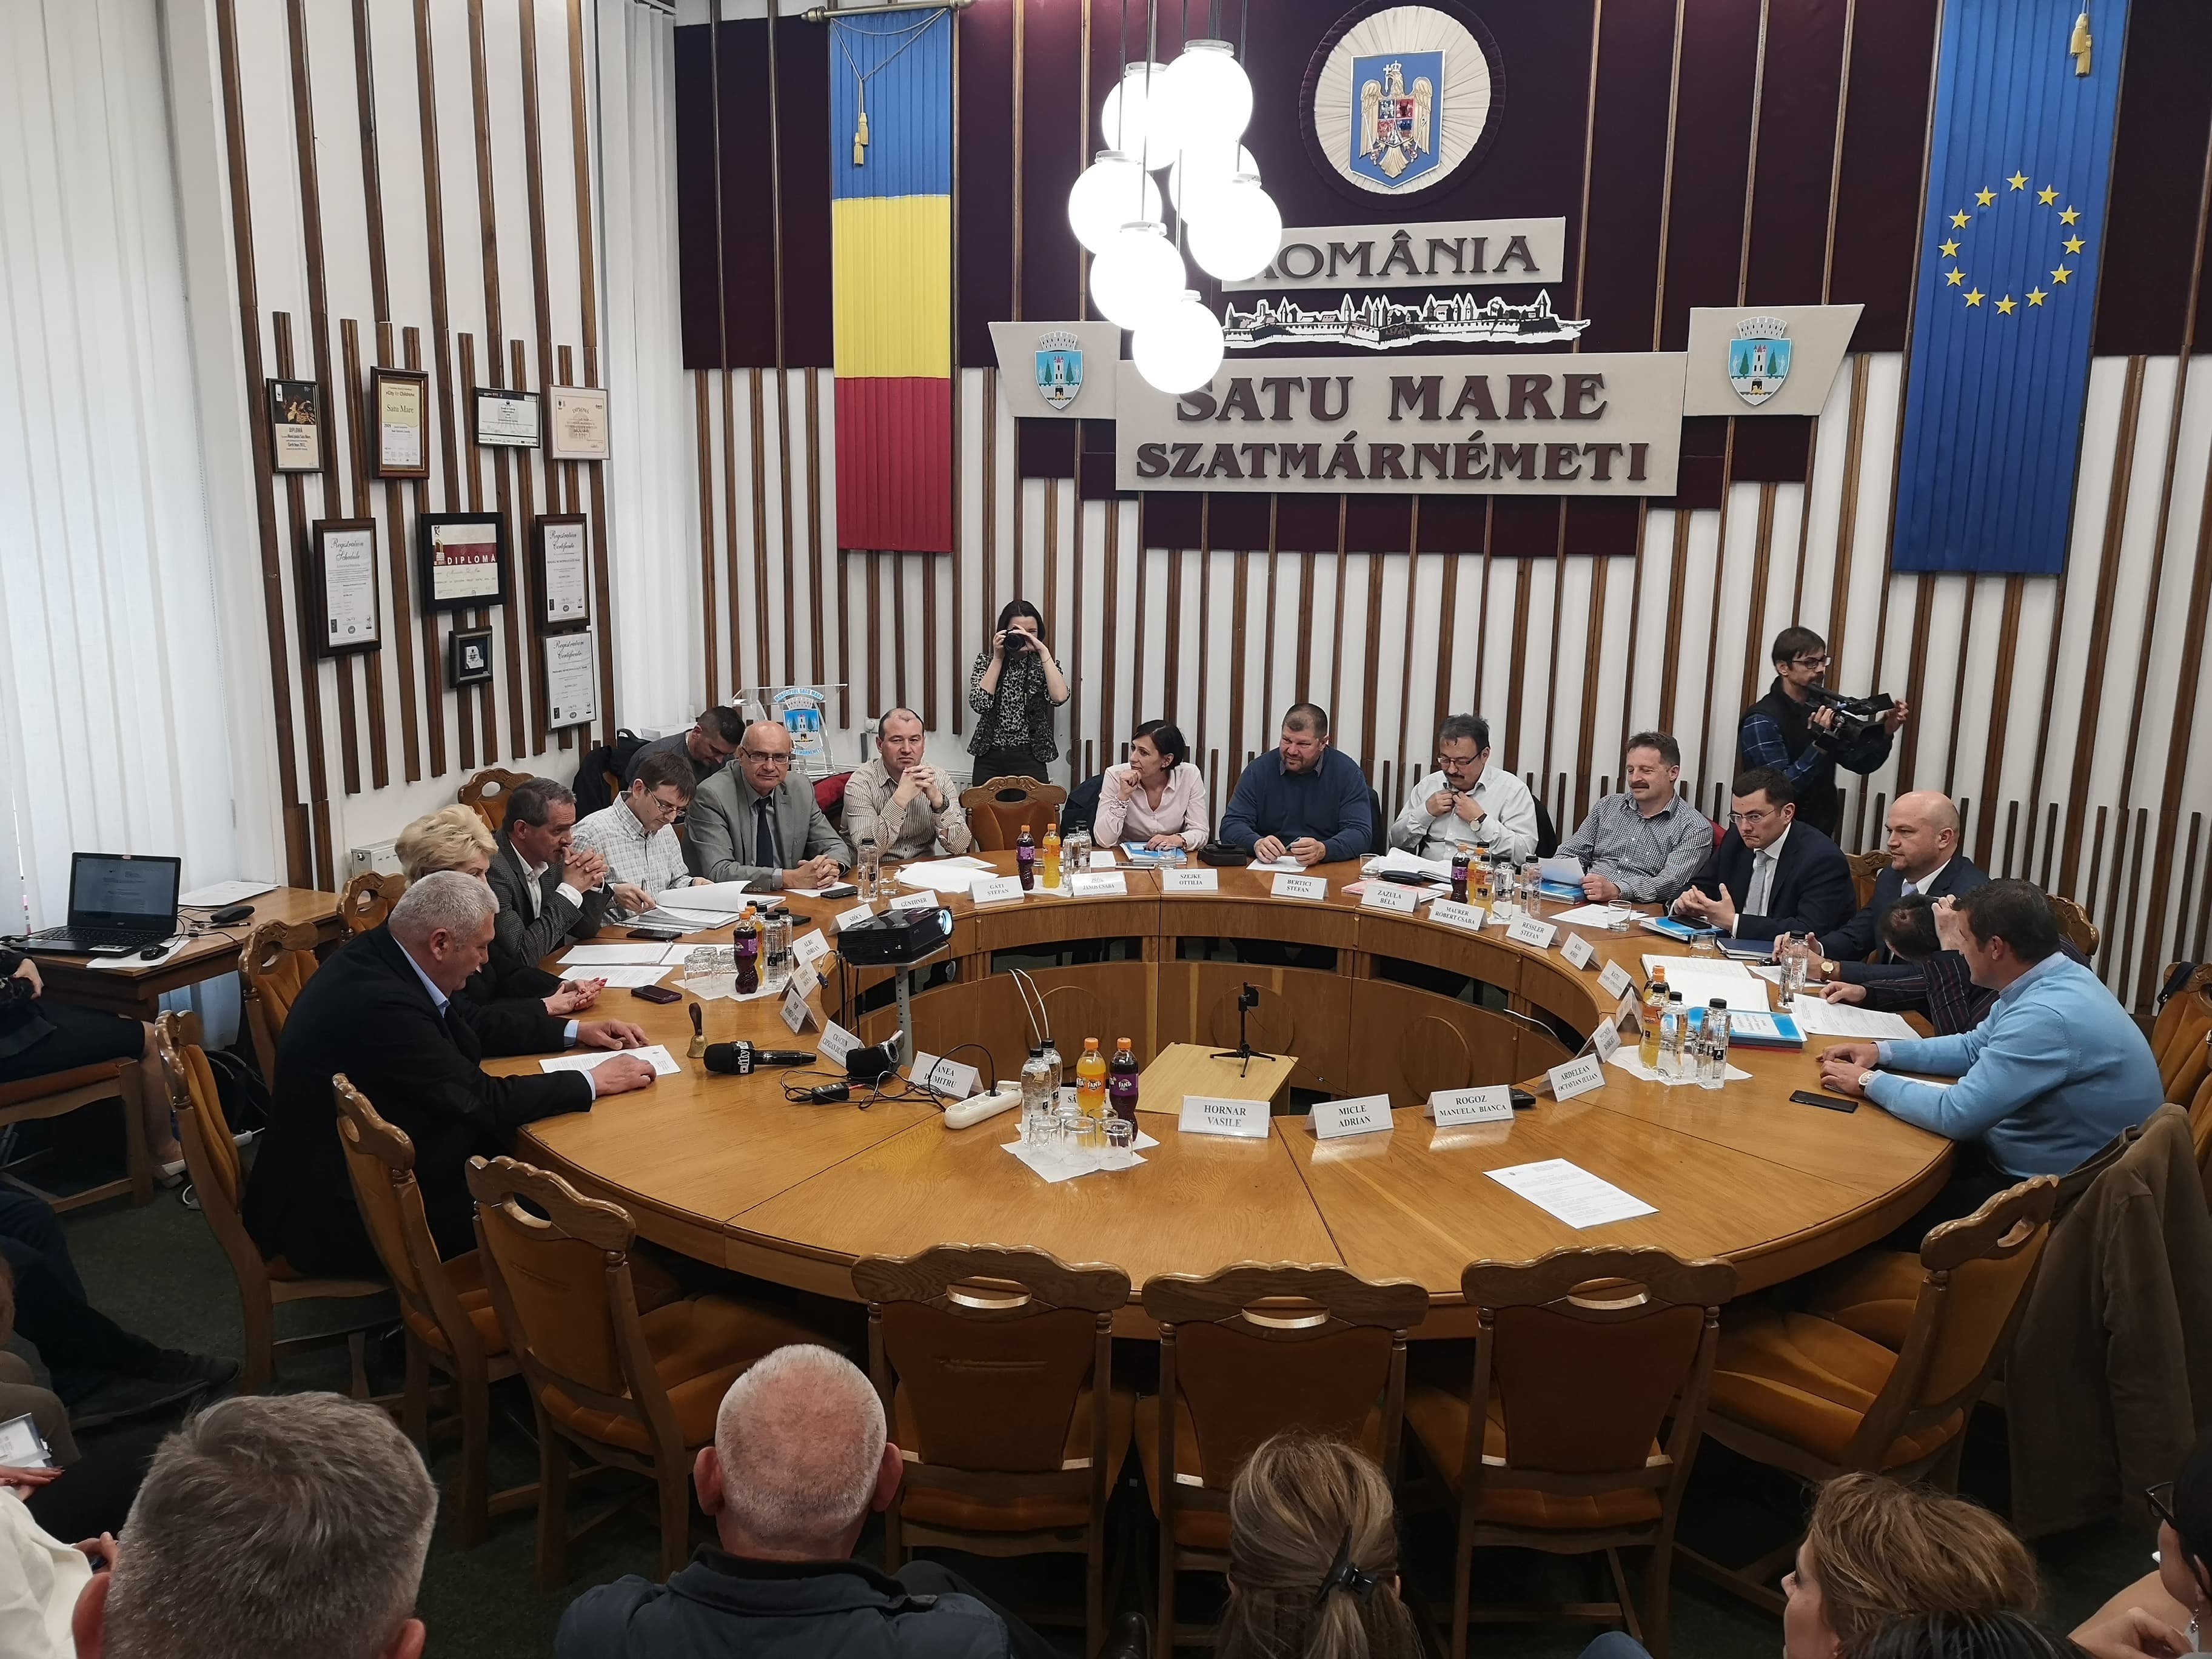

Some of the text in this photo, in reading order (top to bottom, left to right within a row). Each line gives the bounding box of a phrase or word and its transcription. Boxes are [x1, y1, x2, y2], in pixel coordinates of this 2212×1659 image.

[1250, 229, 1540, 279] OMÂNIA
[1176, 372, 1607, 421] SATU MARE
[1136, 429, 1649, 481] SZATMÁRNÉMETI
[1377, 890, 1402, 899] ZAZULA
[1446, 907, 1469, 916] MAURER
[1522, 922, 1545, 933] RESSLER
[935, 1065, 955, 1077] ANEA
[1561, 1064, 1590, 1081] ARDELEAN
[1087, 1081, 1102, 1089] FANTA
[1118, 1081, 1132, 1089] FANTA
[1455, 1094, 1487, 1105] ROGOZ
[1204, 1104, 1246, 1116] HORNAR
[1338, 1104, 1367, 1116] MICLE
[1439, 1104, 1507, 1117] MANUELA BIANCA
[1207, 1116, 1241, 1127] VASILE
[1338, 1116, 1371, 1128] ADRIAN
